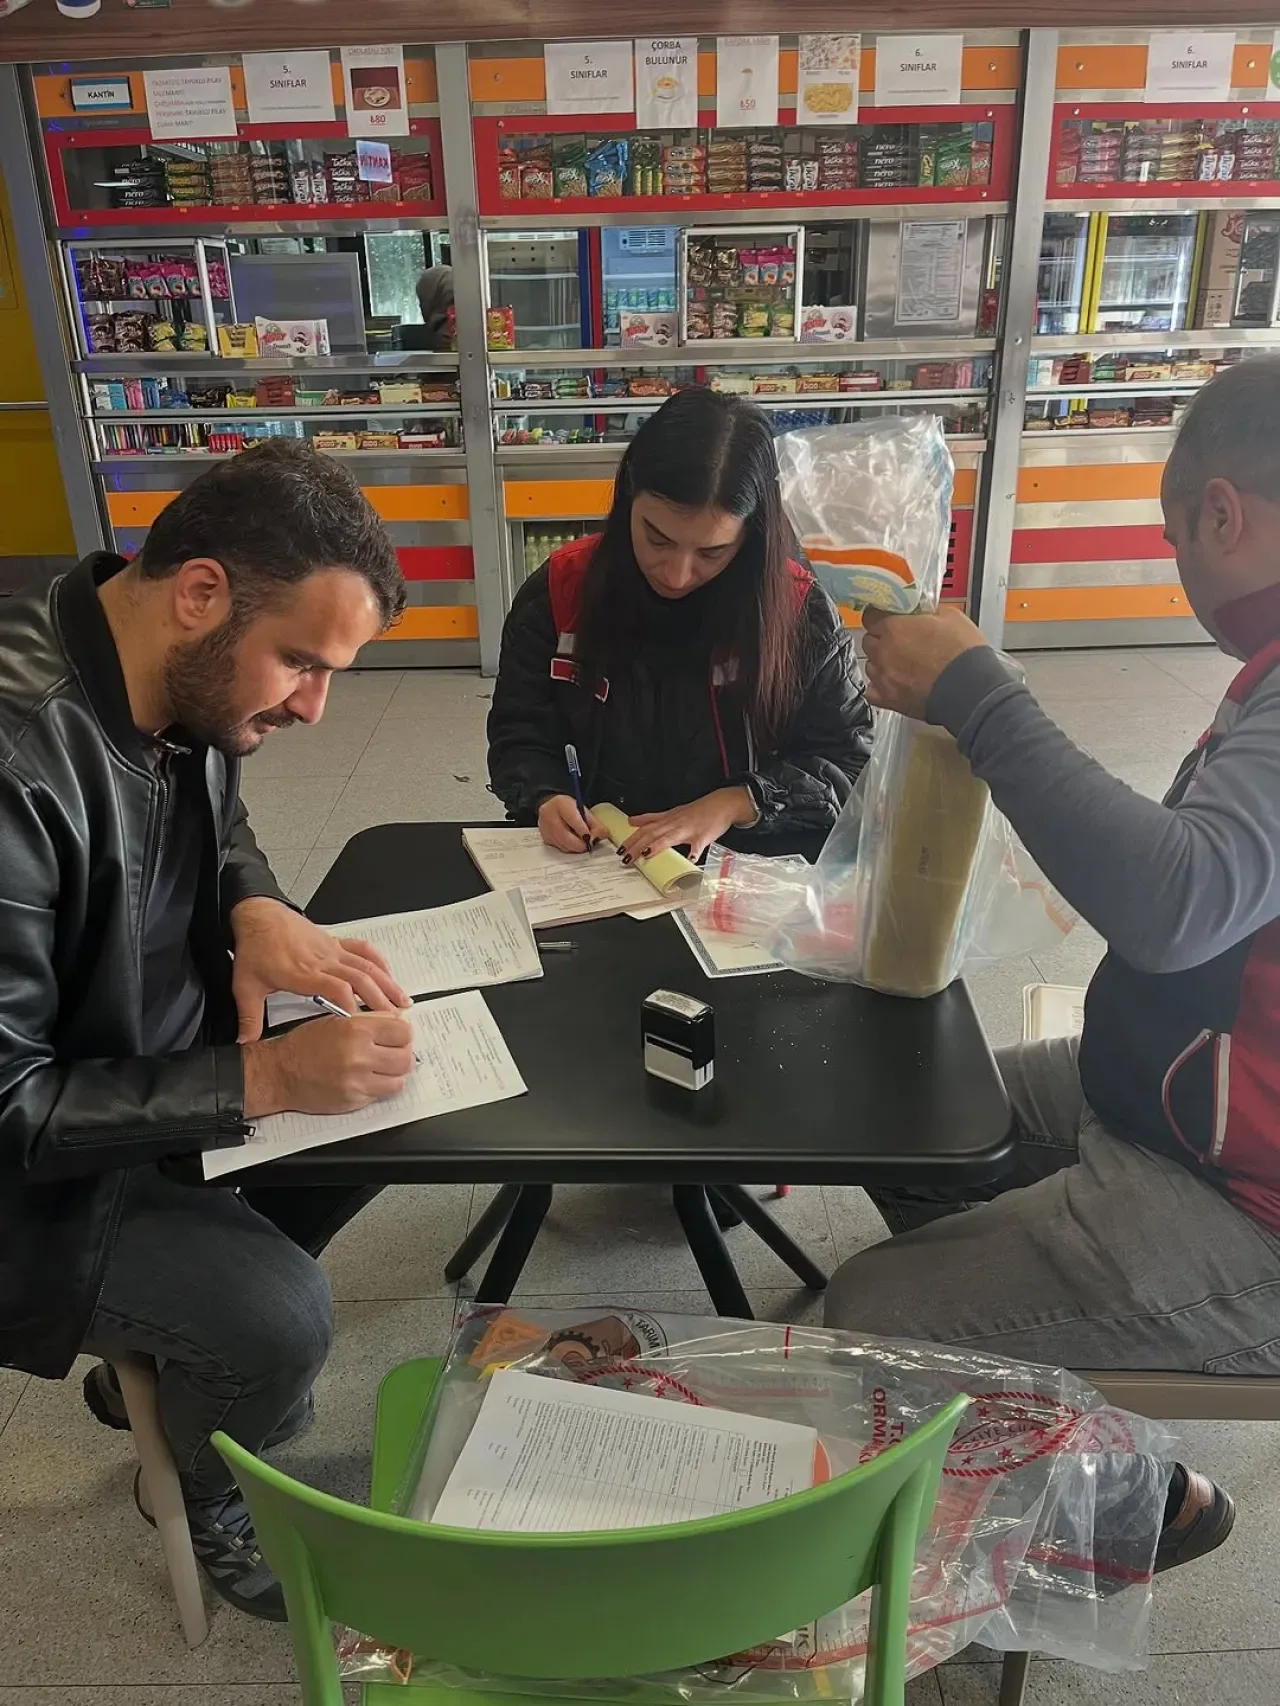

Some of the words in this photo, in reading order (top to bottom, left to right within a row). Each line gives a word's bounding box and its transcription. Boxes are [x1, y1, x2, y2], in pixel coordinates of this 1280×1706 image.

[651, 41, 681, 51] ÇORBA
[1187, 46, 1195, 54] 6.
[915, 49, 923, 57] 6.
[584, 56, 592, 64] 5.
[645, 56, 687, 65] BULUNUR
[283, 65, 291, 73] 5.
[900, 63, 937, 72] SINIFLAR
[1171, 61, 1207, 69] SINIFLAR
[570, 69, 608, 78] SINIFLAR
[270, 79, 307, 88] SINIFLAR
[87, 90, 115, 99] KANTİN
[635, 1319, 660, 1349] TARIM
